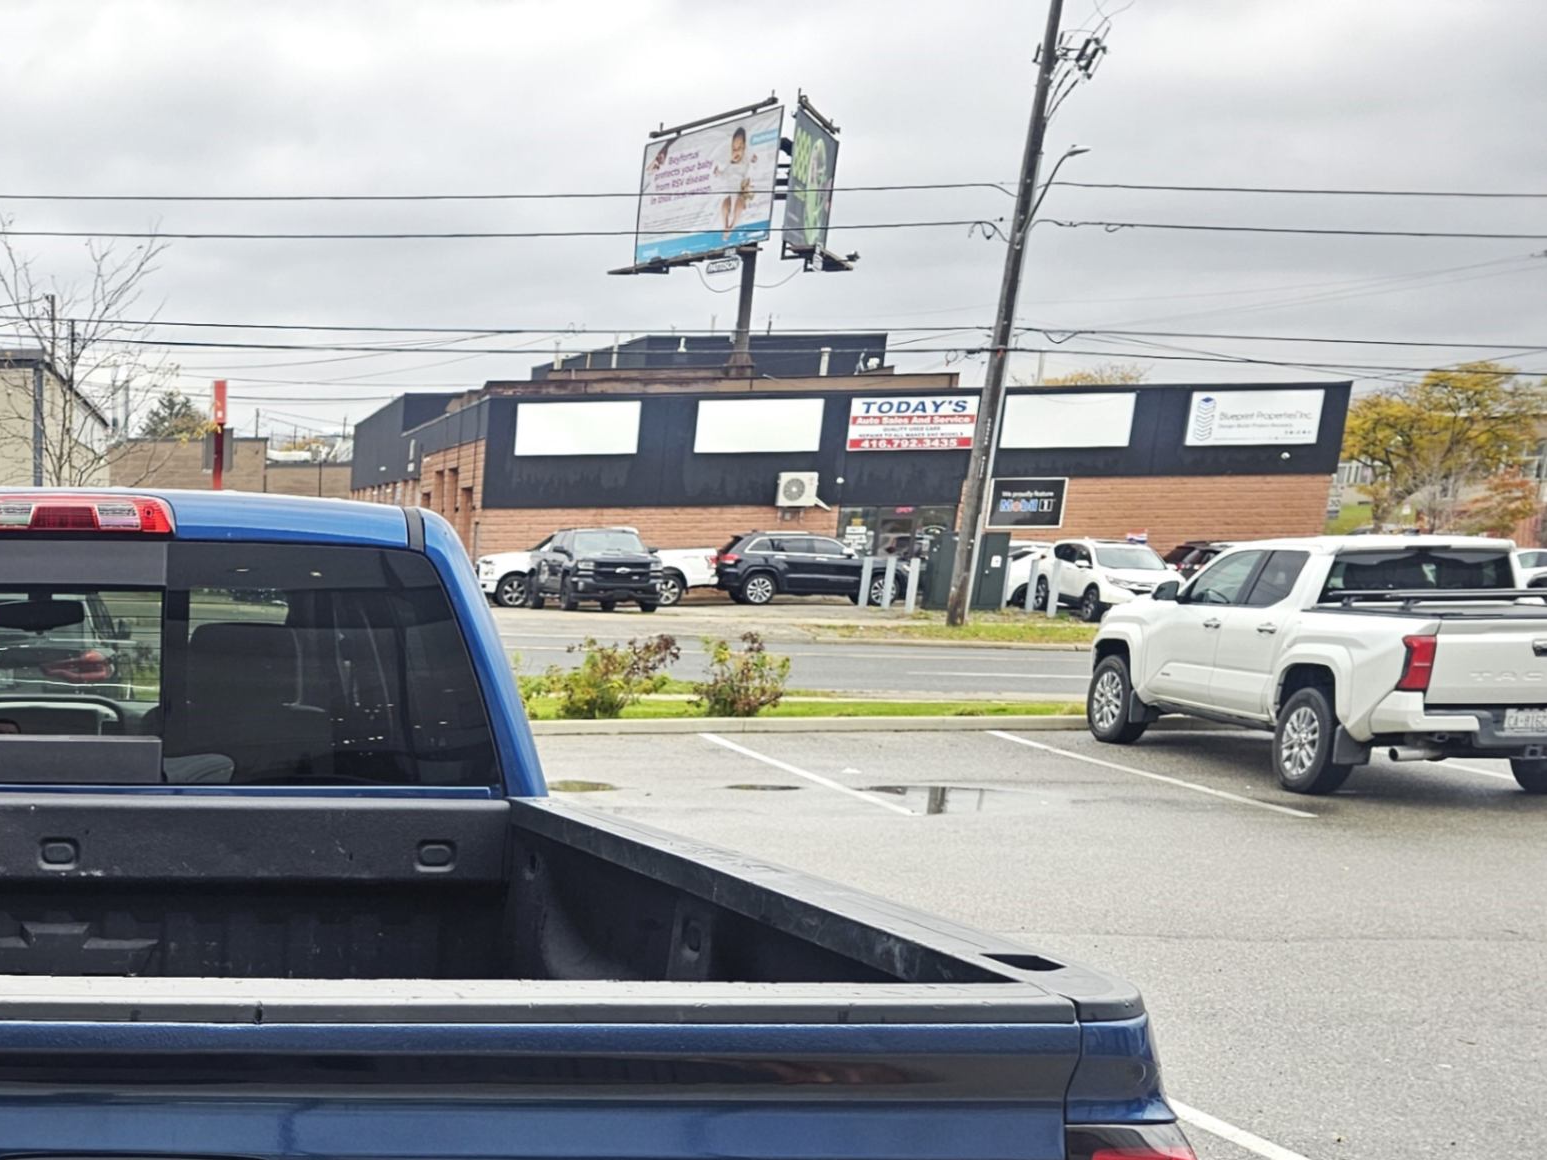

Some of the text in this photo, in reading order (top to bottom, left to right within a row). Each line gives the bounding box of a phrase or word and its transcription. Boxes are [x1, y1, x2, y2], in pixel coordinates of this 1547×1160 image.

[861, 400, 969, 414] TODAY'S
[855, 415, 971, 425] Auto Sales And Service
[859, 438, 958, 448] 416.792.3435
